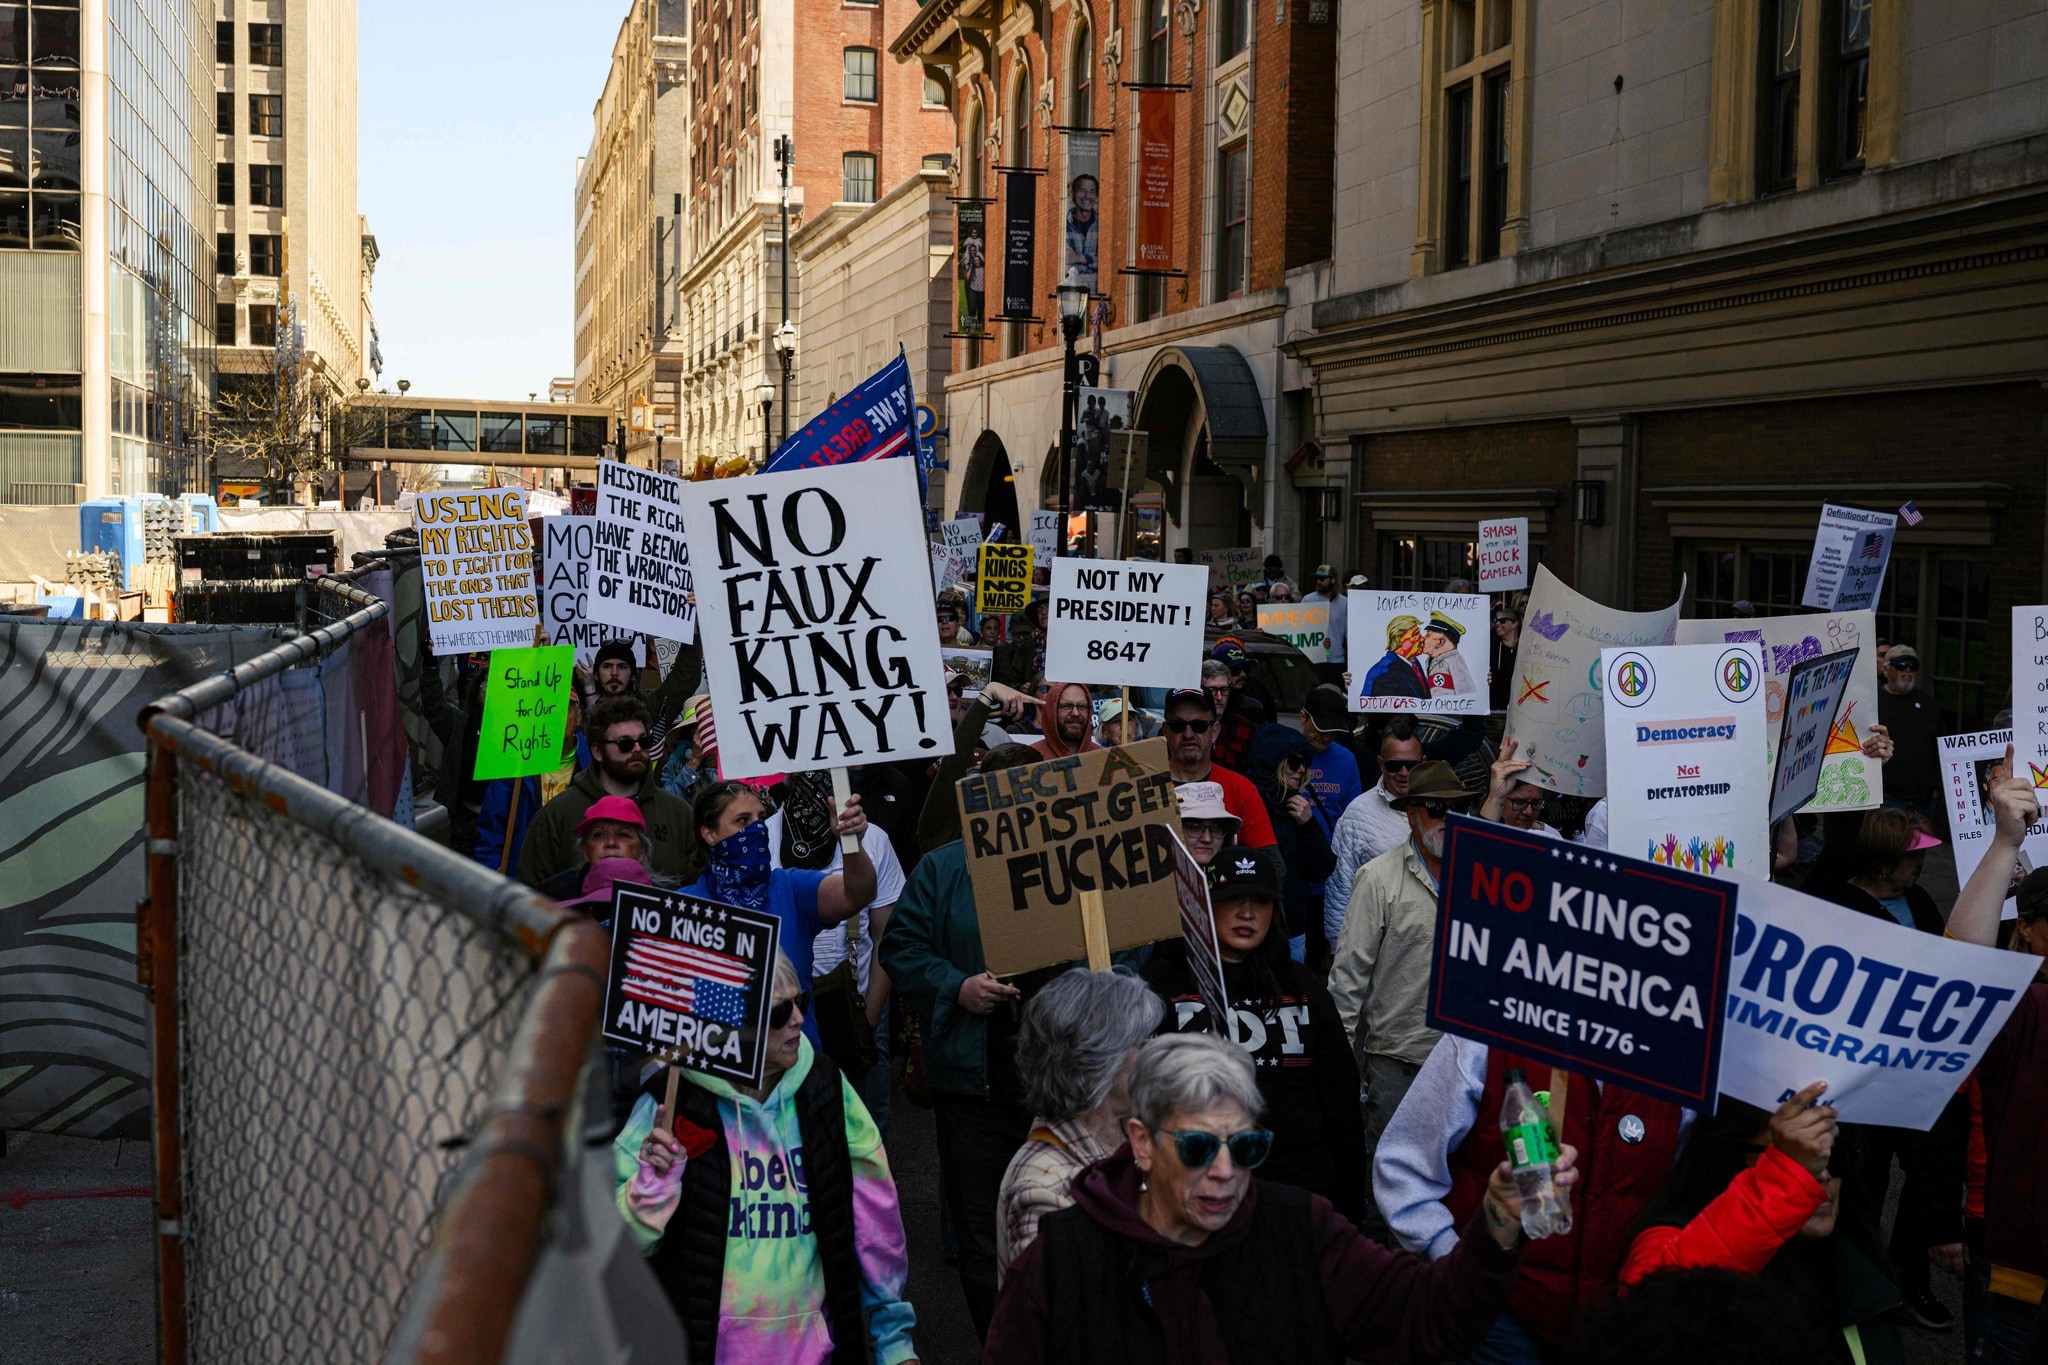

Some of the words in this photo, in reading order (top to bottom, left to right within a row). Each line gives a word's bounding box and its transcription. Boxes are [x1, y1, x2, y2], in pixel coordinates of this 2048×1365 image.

[603, 464, 680, 505] HISTORIC
[416, 492, 524, 524] USING
[606, 494, 641, 520] THE
[647, 503, 685, 533] RIGH
[1871, 515, 1894, 525] Trump
[421, 528, 450, 554] MY
[455, 523, 530, 554] RIGHTS
[596, 520, 634, 550] HAVE
[709, 487, 847, 570] NO
[943, 524, 960, 536] NO
[948, 533, 982, 547] KINGS
[1483, 525, 1517, 538] SMASH
[986, 546, 1028, 558] NO
[1504, 537, 1518, 546] local
[425, 560, 447, 577] TO
[453, 555, 502, 576] FIGHT
[505, 552, 533, 570] FOR
[594, 546, 621, 574] THE
[1481, 548, 1520, 565] FLOCK
[1816, 560, 1846, 569] Authoritaria
[985, 560, 1026, 579] KINGS
[1077, 569, 1120, 591] NOT
[1128, 572, 1164, 593] MY
[1480, 565, 1522, 580] CAMERA
[1847, 566, 1861, 576] This
[1862, 565, 1882, 576] Stands
[427, 579, 458, 597] THE
[460, 578, 493, 594] ONES
[496, 573, 530, 591] THAT
[984, 580, 1026, 592] NO
[1854, 579, 1866, 590] For
[430, 598, 475, 622] LOST
[478, 595, 537, 619] THEIRS
[598, 575, 623, 598] OF
[629, 581, 696, 621] HISTORY
[723, 556, 886, 638] FAUX
[983, 593, 1024, 608] WARS
[1377, 595, 1418, 611] LOVERS
[1423, 596, 1436, 611] BY
[1438, 596, 1480, 610] CHANCE
[1838, 592, 1872, 604] Democracy
[1258, 608, 1329, 628] IMPEACH
[435, 628, 536, 648] #WHERESTHEHUMANIT
[1280, 632, 1324, 648] RUMP
[1087, 640, 1151, 662] 8647
[729, 624, 920, 704] KING
[505, 667, 540, 689] Stand
[546, 663, 561, 693] Up
[1792, 670, 1812, 704] WE
[516, 699, 532, 718] for
[534, 698, 556, 717] Our
[1360, 697, 1417, 710] DICTATORS
[1420, 700, 1431, 711] BY
[1435, 699, 1476, 711] CHOICE
[740, 690, 938, 762] WAY!
[1636, 721, 1736, 744] Democracy
[502, 724, 551, 761] Rights
[1944, 736, 1976, 750] WAR
[1979, 730, 2012, 746] CRIM
[961, 756, 1082, 814] ELECT
[1099, 747, 1144, 786] A
[1677, 764, 1700, 777] Not
[1107, 771, 1172, 822] GET
[1647, 781, 1731, 800] DICTATORSHIP
[1951, 763, 1966, 822] TRUMP
[1965, 761, 1982, 825] EPSTEIN
[1959, 830, 1982, 841] FILES
[1007, 825, 1174, 911] FUCKED
[1470, 861, 1534, 914] NO
[1549, 881, 1693, 958] KINGS
[632, 907, 661, 934] NO
[670, 915, 726, 950] KINGS
[736, 932, 756, 959] IN
[1448, 919, 1492, 968] IN
[1503, 936, 1704, 1029] AMERICA
[617, 1001, 743, 1065] AMERICA
[1727, 994, 1970, 1074] MIGRANTS
[740, 1150, 786, 1191] be
